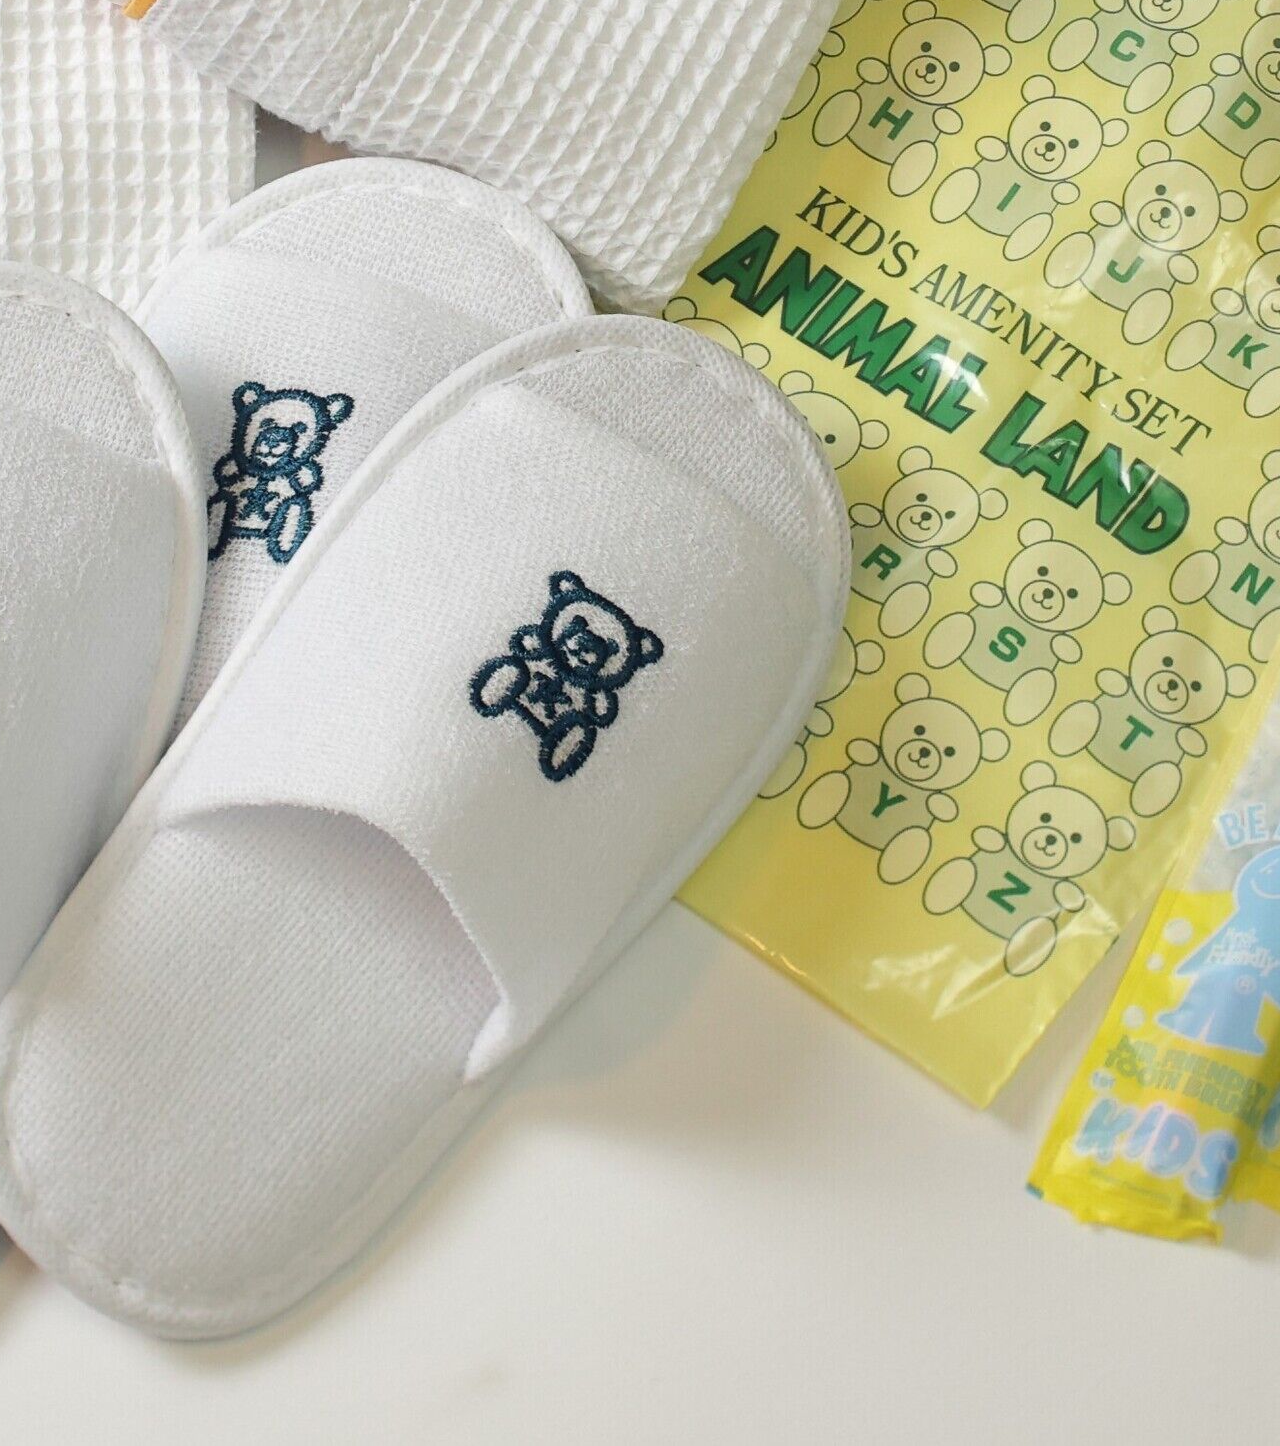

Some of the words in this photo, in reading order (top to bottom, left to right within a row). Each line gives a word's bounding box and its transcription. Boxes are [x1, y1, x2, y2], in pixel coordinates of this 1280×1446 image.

[1108, 29, 1145, 63] C
[1224, 91, 1263, 131] D
[867, 96, 914, 141] H
[995, 182, 1021, 212] I
[1106, 256, 1144, 285] J
[1227, 334, 1269, 370] K
[794, 185, 921, 279] KID'S
[910, 262, 1124, 402] AMENITY
[1111, 387, 1212, 457] SET
[697, 224, 988, 435] ANIMAL
[979, 390, 1191, 556] LAND
[860, 543, 902, 581] R
[987, 625, 1027, 664] S
[1119, 714, 1154, 751] T
[1230, 563, 1276, 607] N
[870, 781, 908, 819] Y
[986, 871, 1032, 915] Z
[1216, 804, 1268, 851] BE
[1074, 1096, 1240, 1202] KIDS
